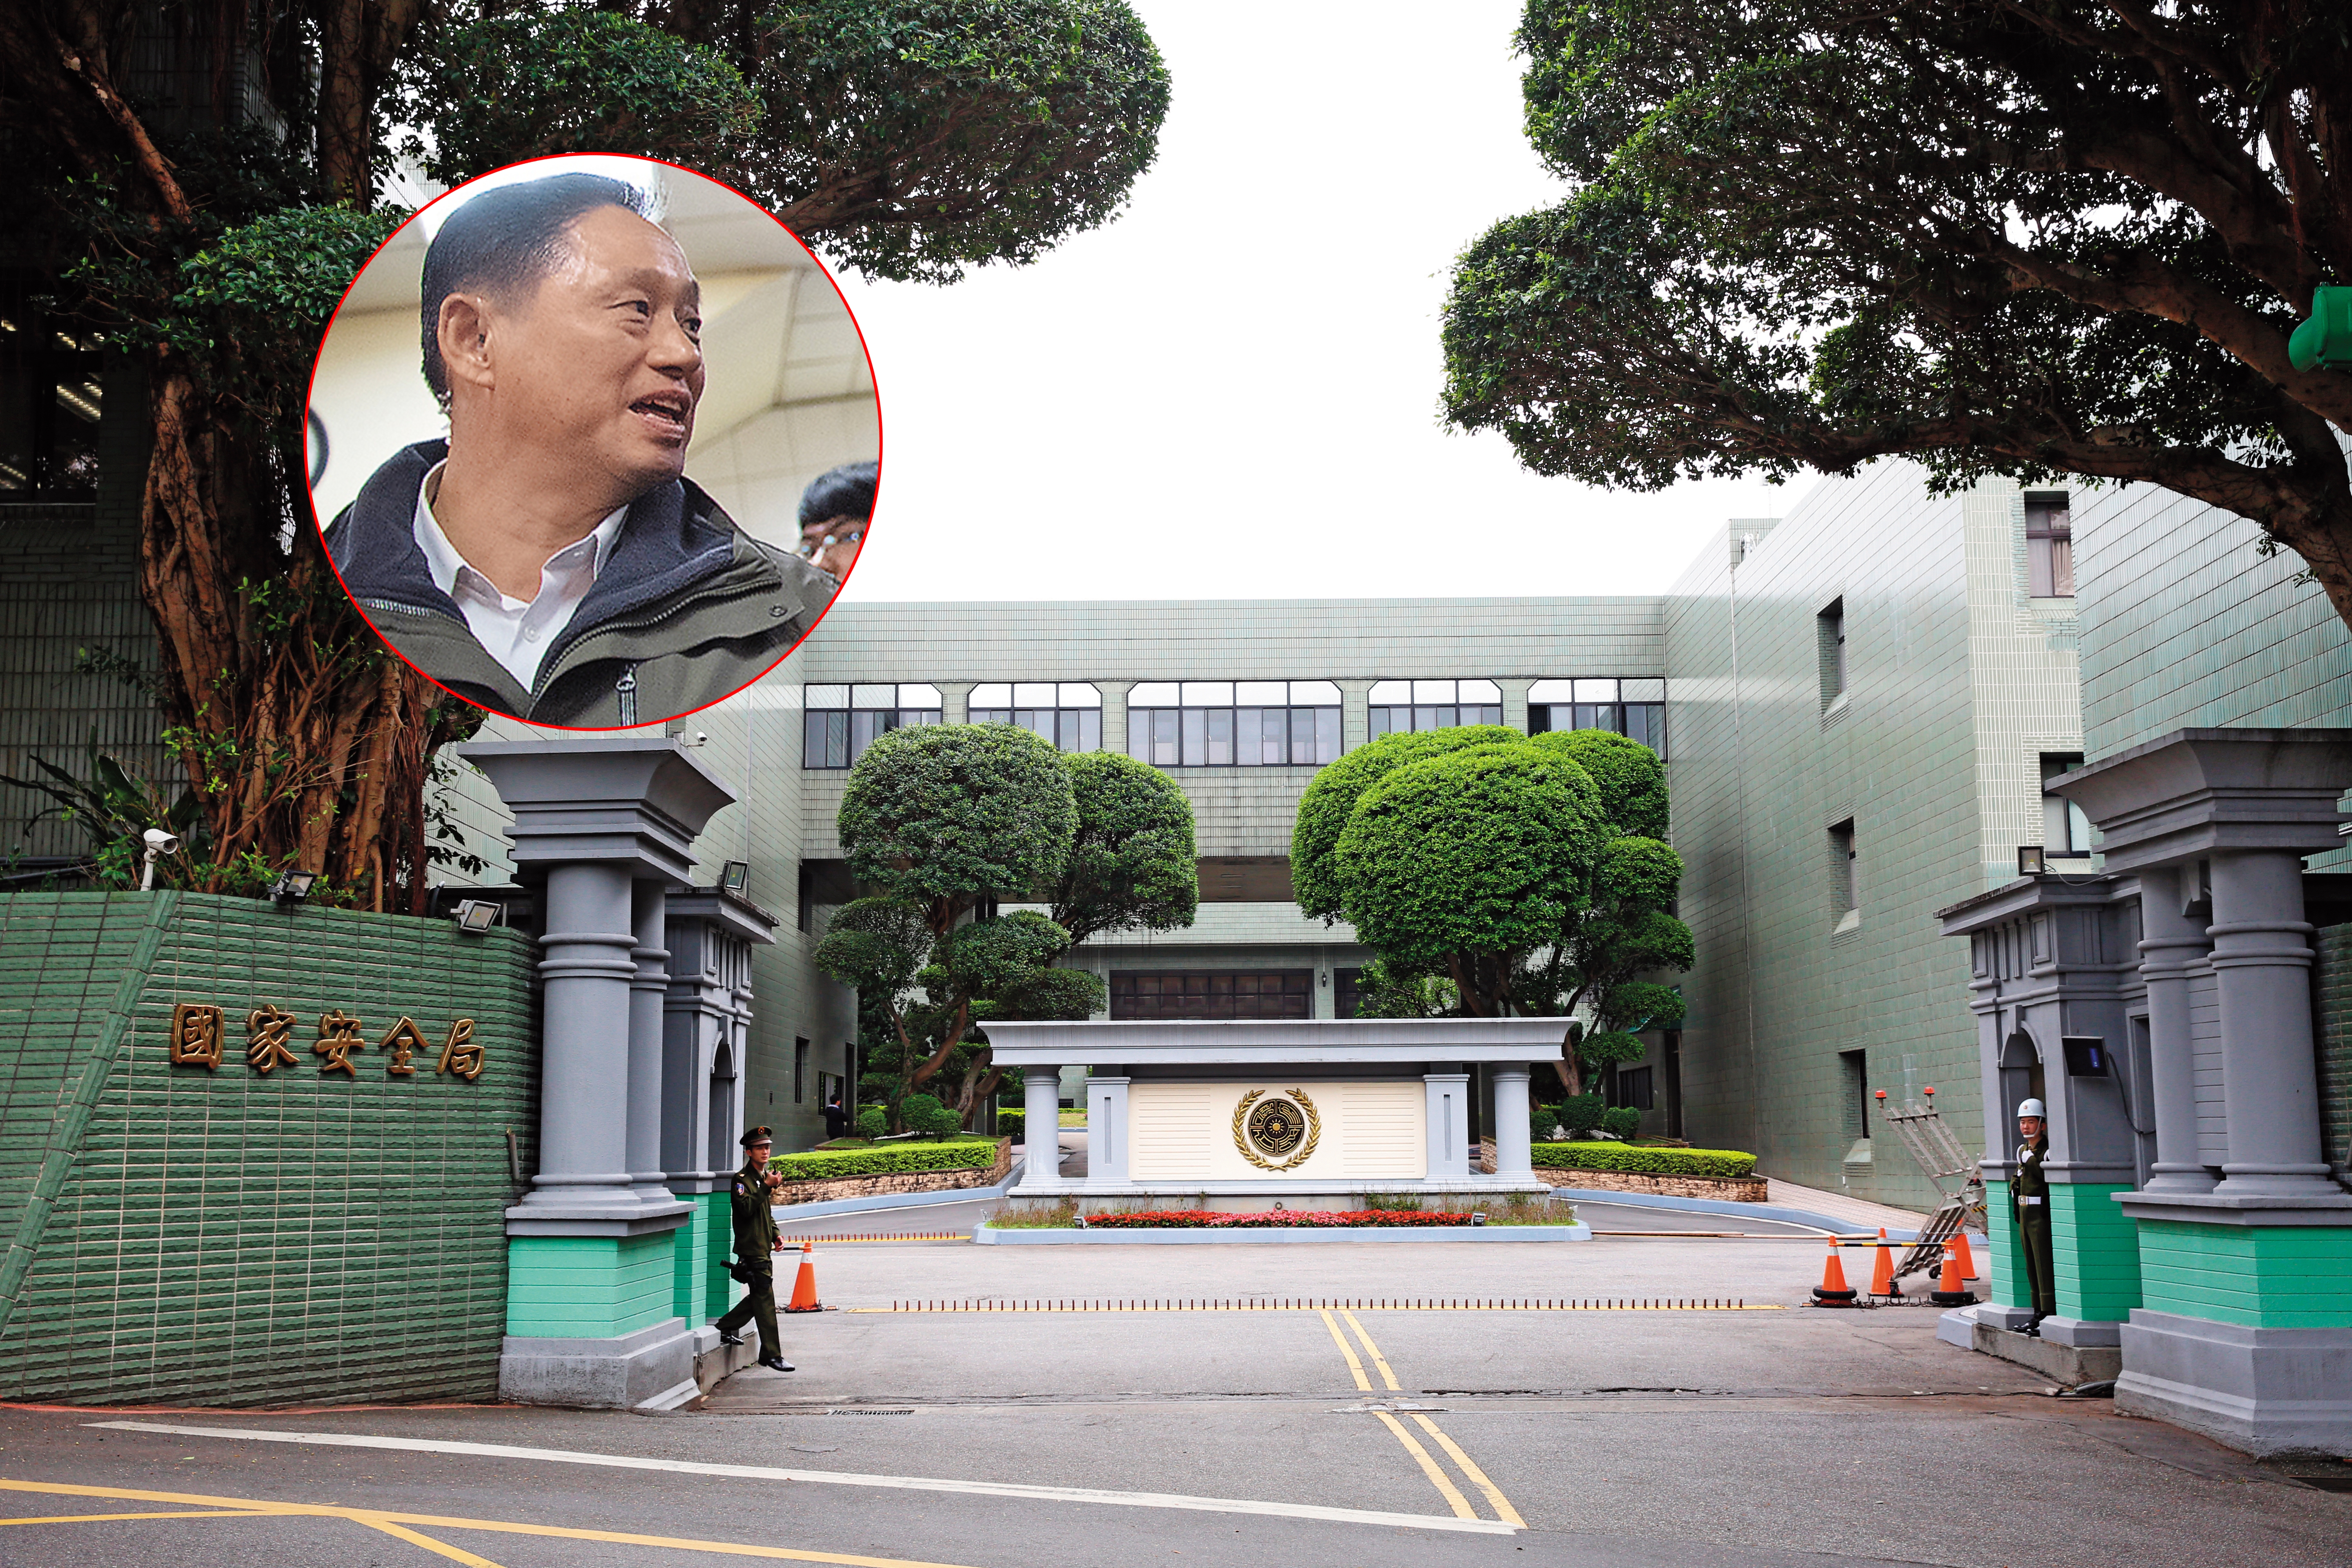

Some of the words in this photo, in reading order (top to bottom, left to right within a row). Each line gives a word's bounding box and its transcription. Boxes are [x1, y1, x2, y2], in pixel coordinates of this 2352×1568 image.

[171, 1003, 484, 1079] 國家安全局
